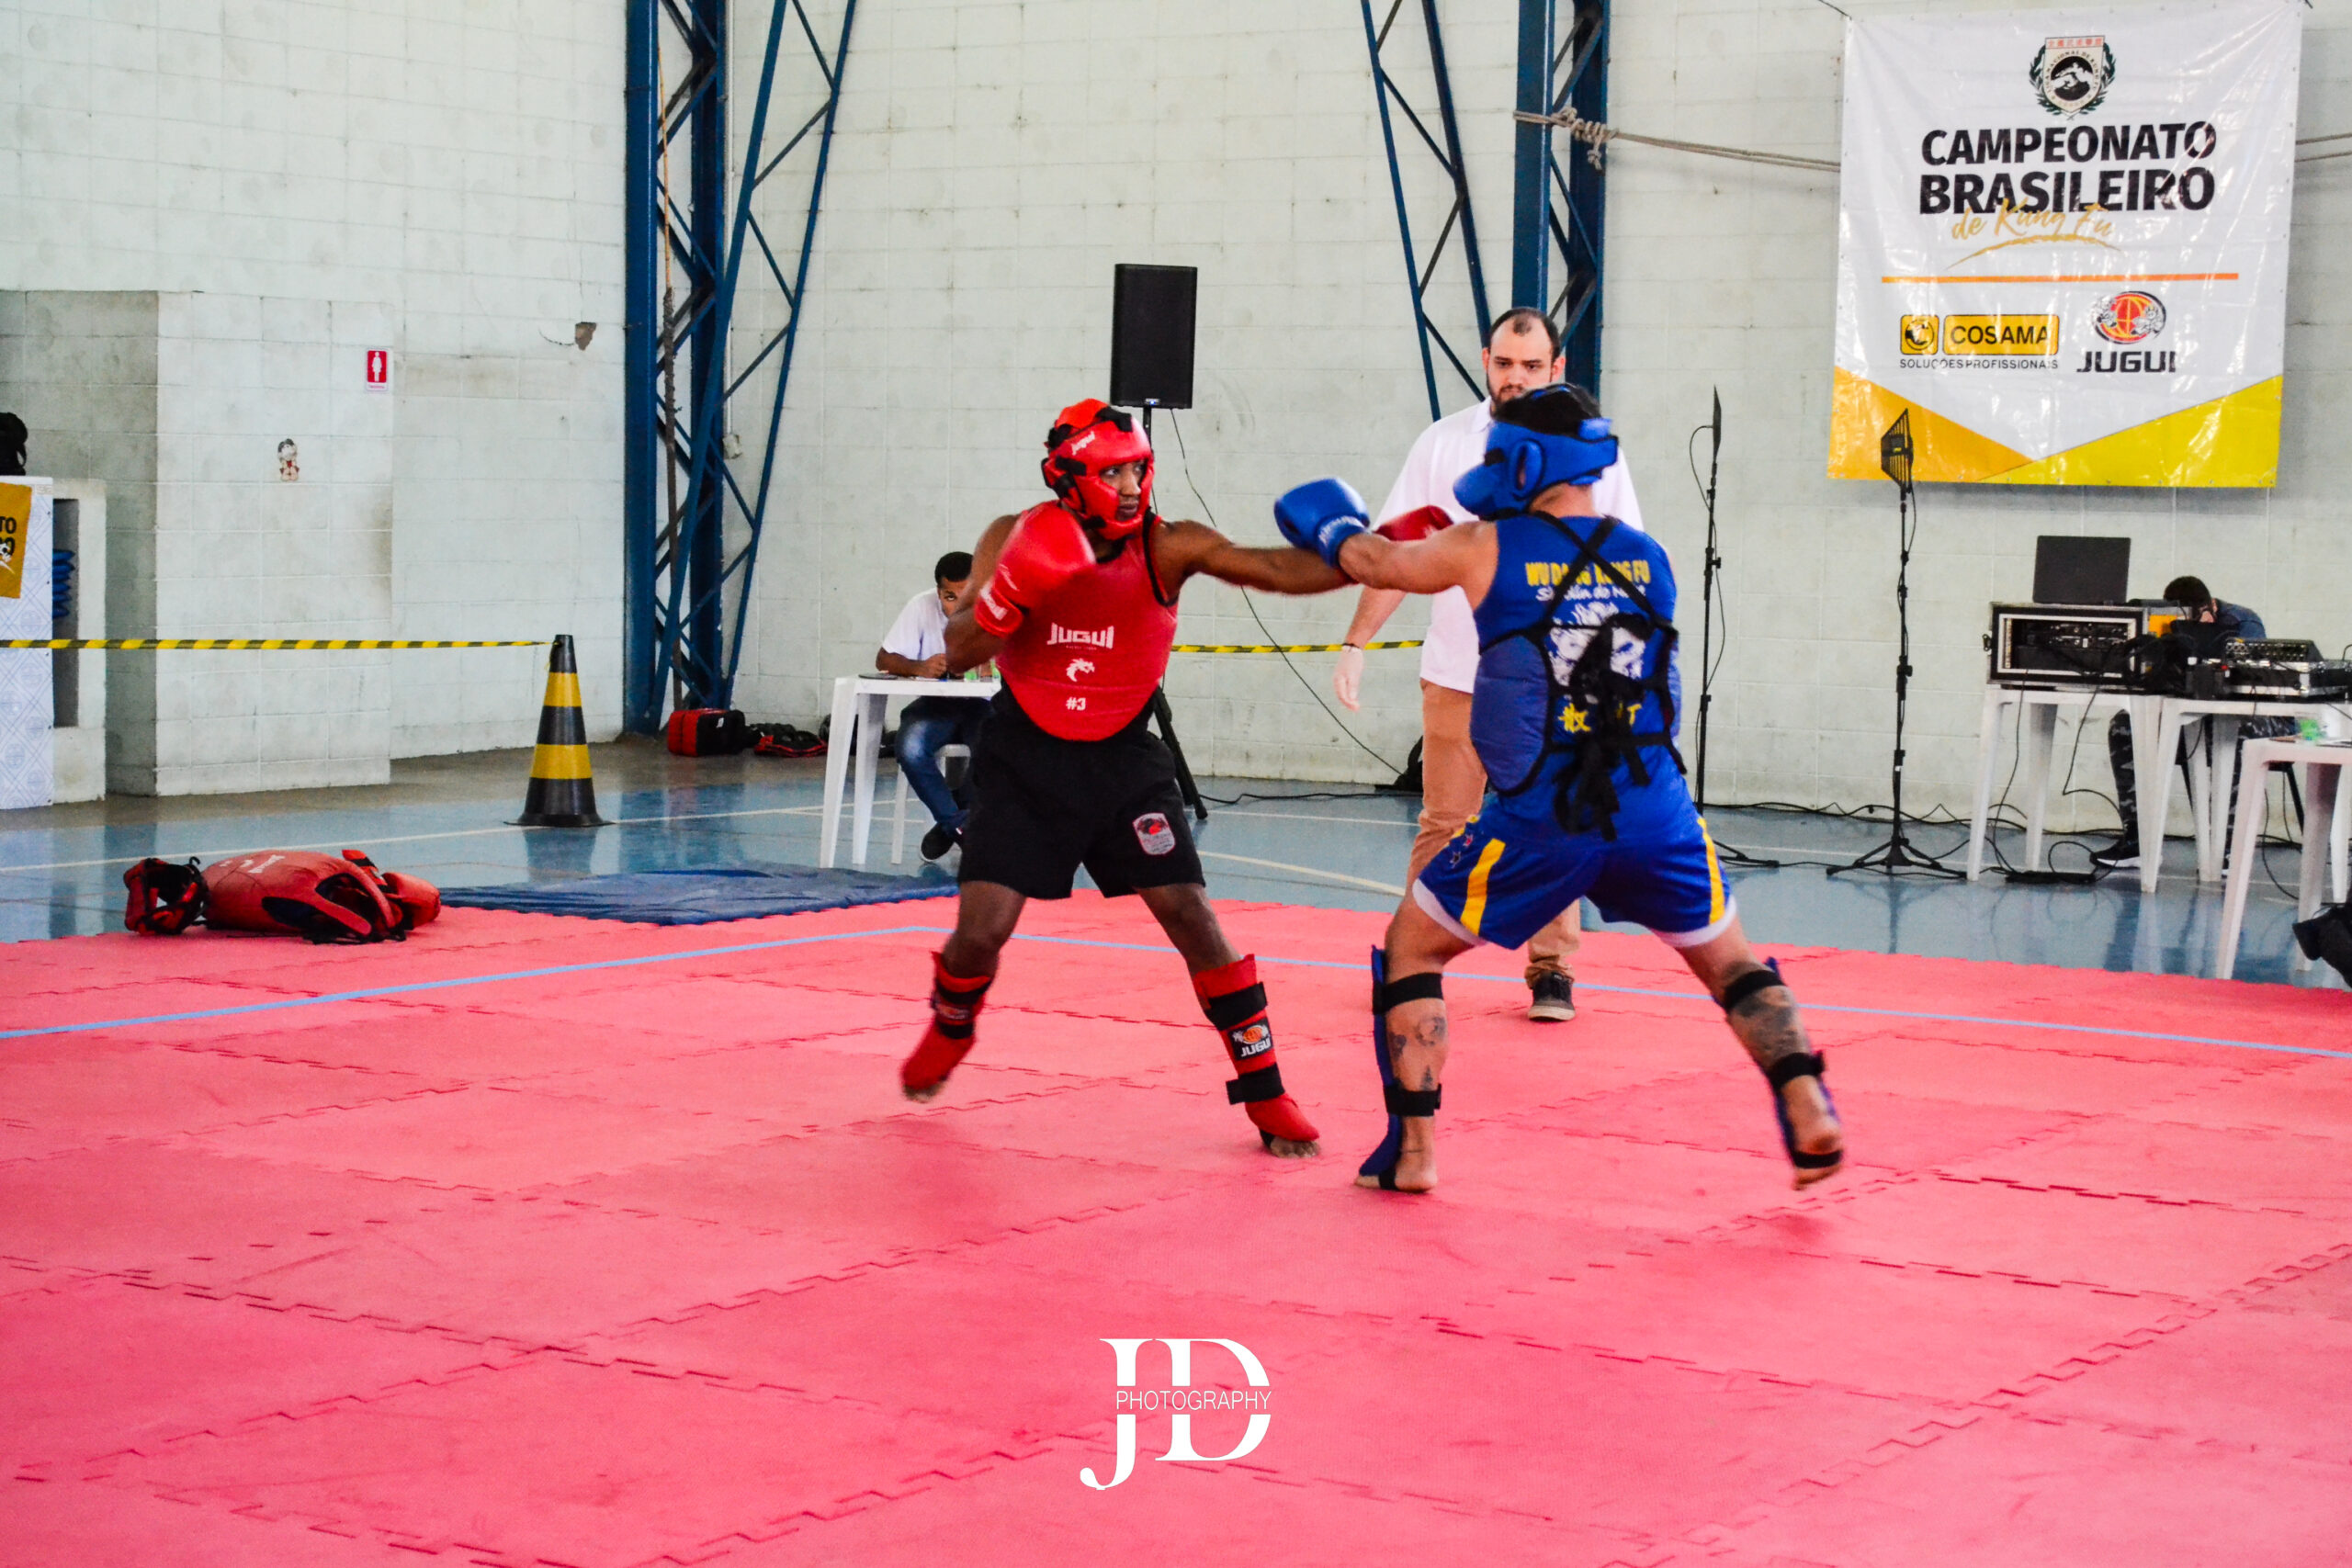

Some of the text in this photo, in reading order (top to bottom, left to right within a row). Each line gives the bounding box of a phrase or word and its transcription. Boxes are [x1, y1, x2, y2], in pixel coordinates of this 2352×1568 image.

[1921, 121, 2217, 165] CAMPEONATO
[1919, 166, 2216, 215] BRASILEIRO
[1951, 197, 2113, 240] de Kung Fu
[1950, 324, 2049, 345] COSAMA
[2076, 350, 2177, 373] JUGUI
[1046, 622, 1114, 649] JUGUI
[1066, 696, 1086, 711] #3
